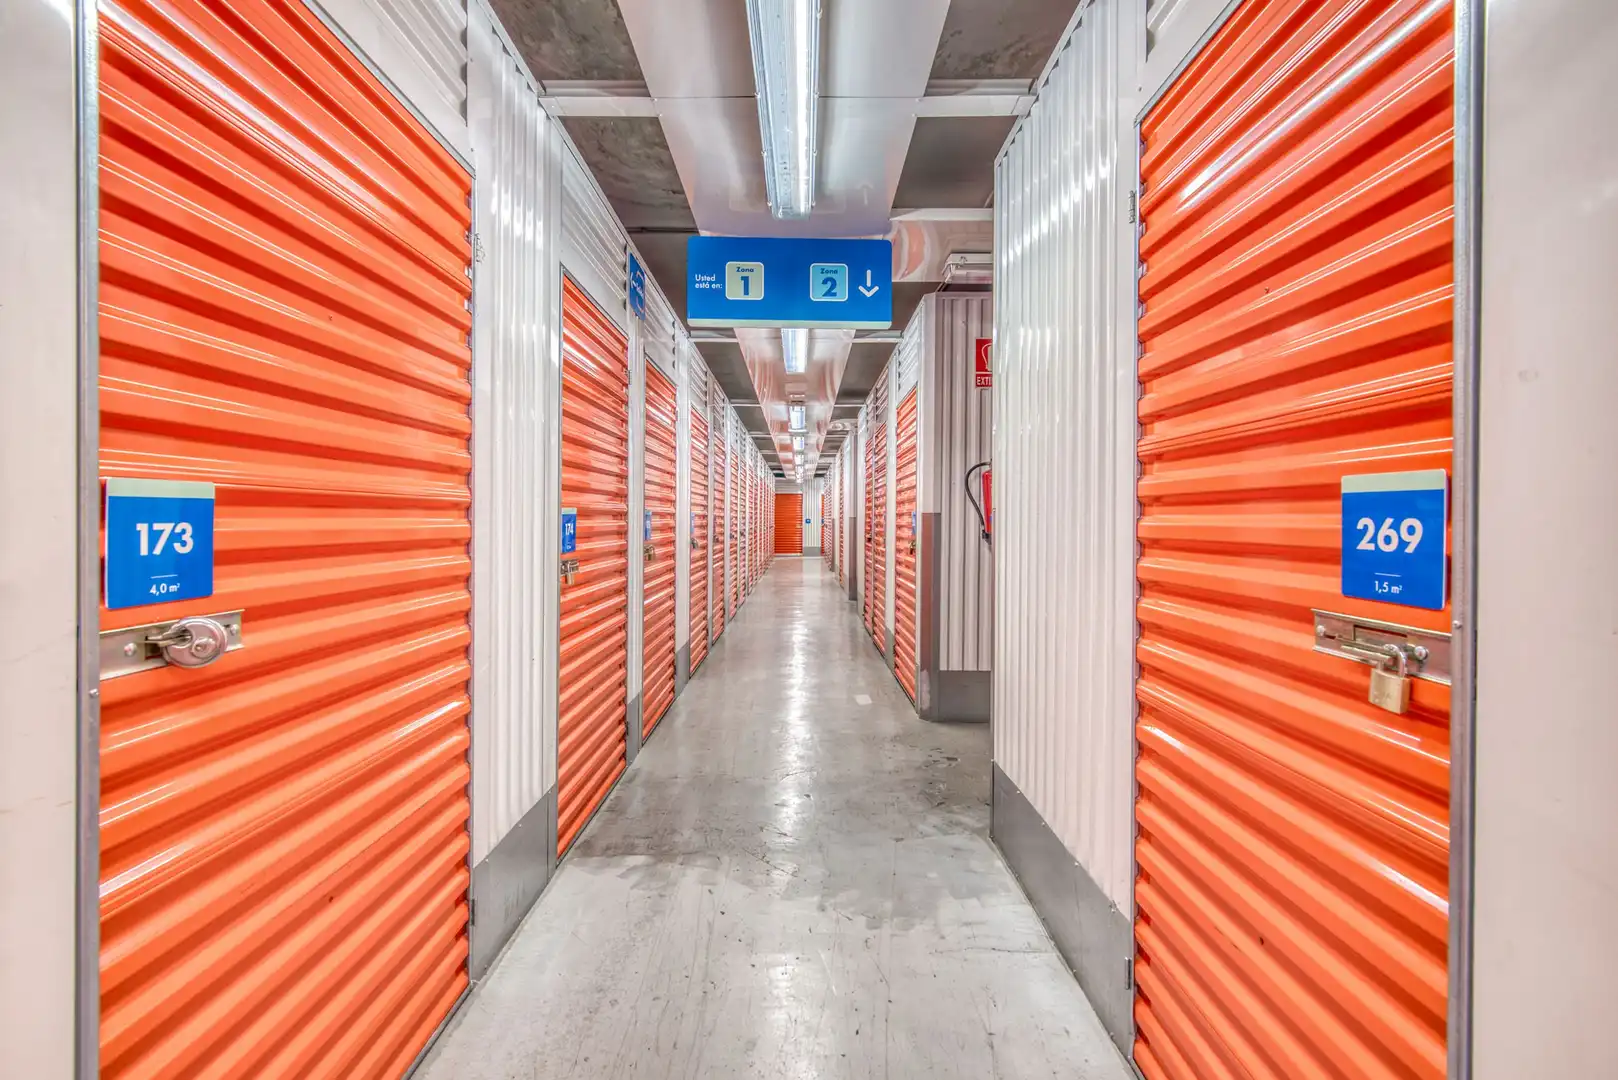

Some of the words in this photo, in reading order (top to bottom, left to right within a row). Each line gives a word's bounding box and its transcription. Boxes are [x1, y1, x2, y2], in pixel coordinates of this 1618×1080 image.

[695, 273, 716, 282] Usted
[695, 281, 710, 289] está
[740, 275, 750, 296] 1
[821, 277, 838, 297] 2
[565, 523, 574, 536] 174
[1356, 517, 1424, 554] 269
[135, 522, 194, 556] 173
[149, 583, 167, 596] 4,0
[1374, 580, 1389, 594] 1,5
